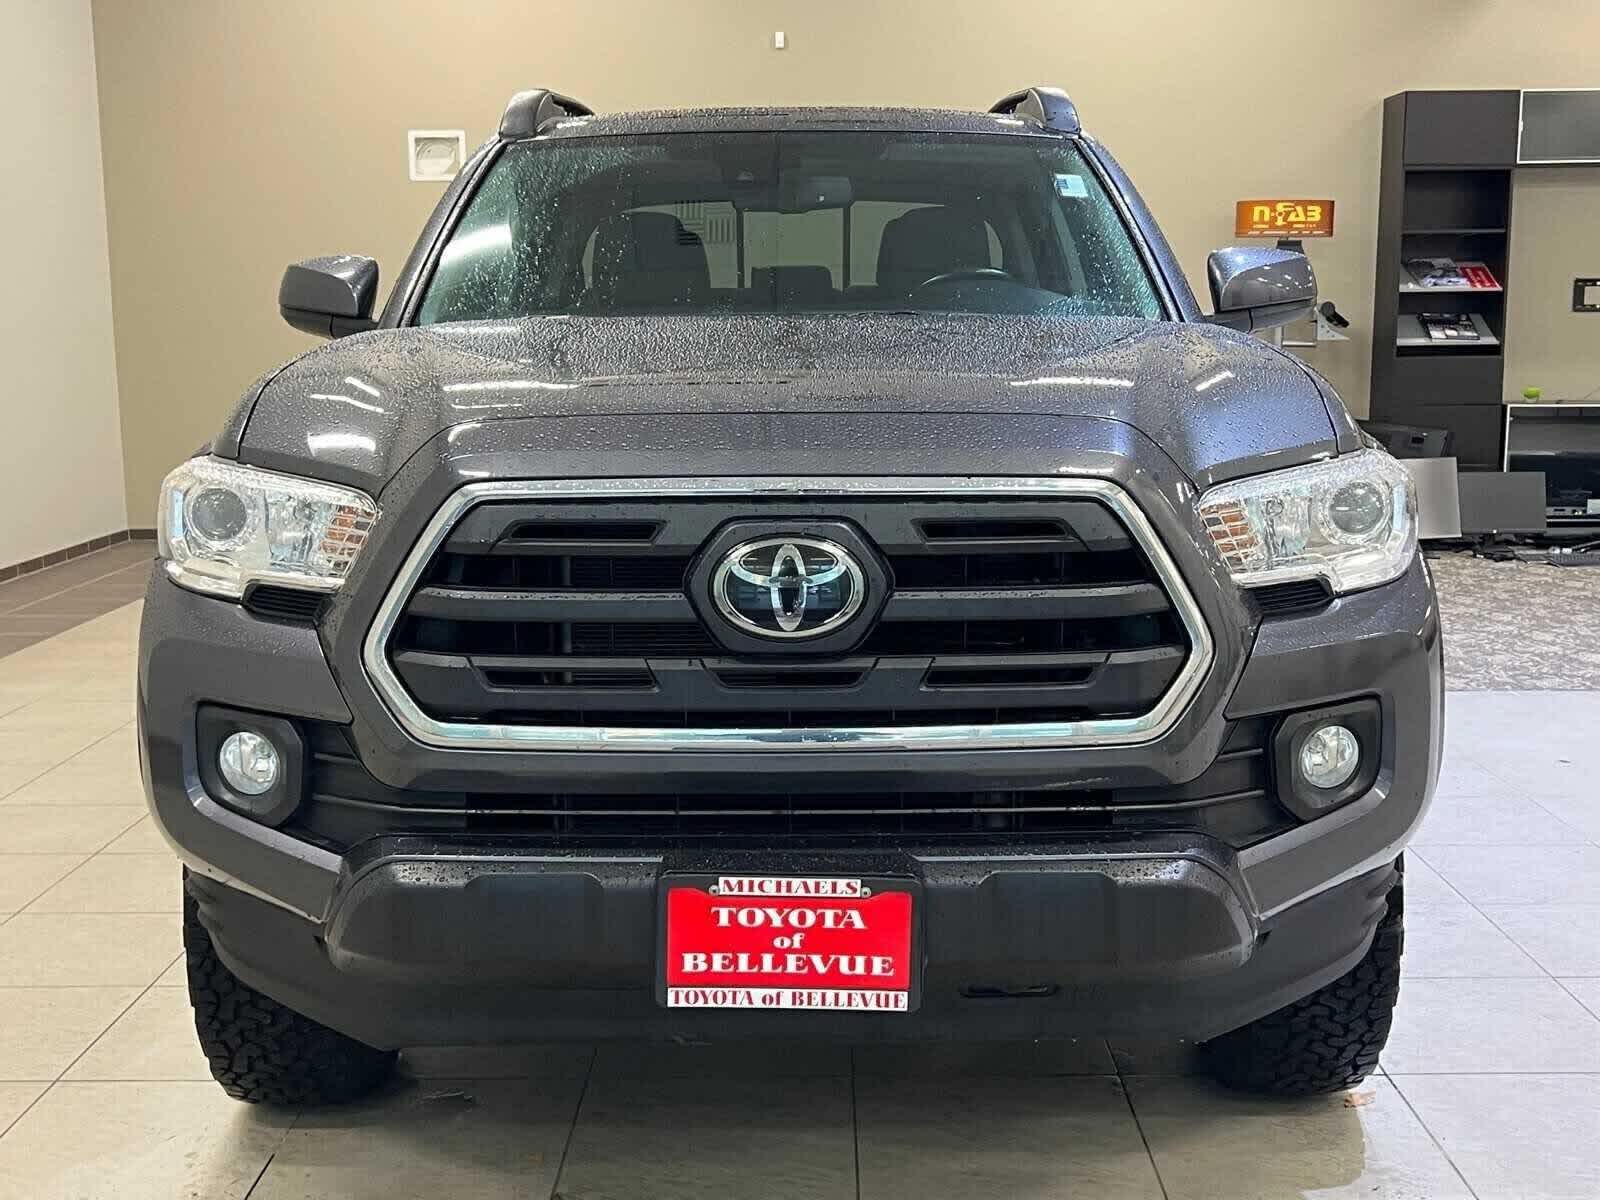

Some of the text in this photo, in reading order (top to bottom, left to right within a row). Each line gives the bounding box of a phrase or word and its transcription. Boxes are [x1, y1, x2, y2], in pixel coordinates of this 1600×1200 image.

[722, 879, 859, 895] MICHAELS
[711, 906, 867, 929] TOYOTA
[773, 932, 805, 949] of
[682, 952, 895, 976] BELLEVUE
[670, 989, 906, 1009] TOYOTA of BELLEVUE
